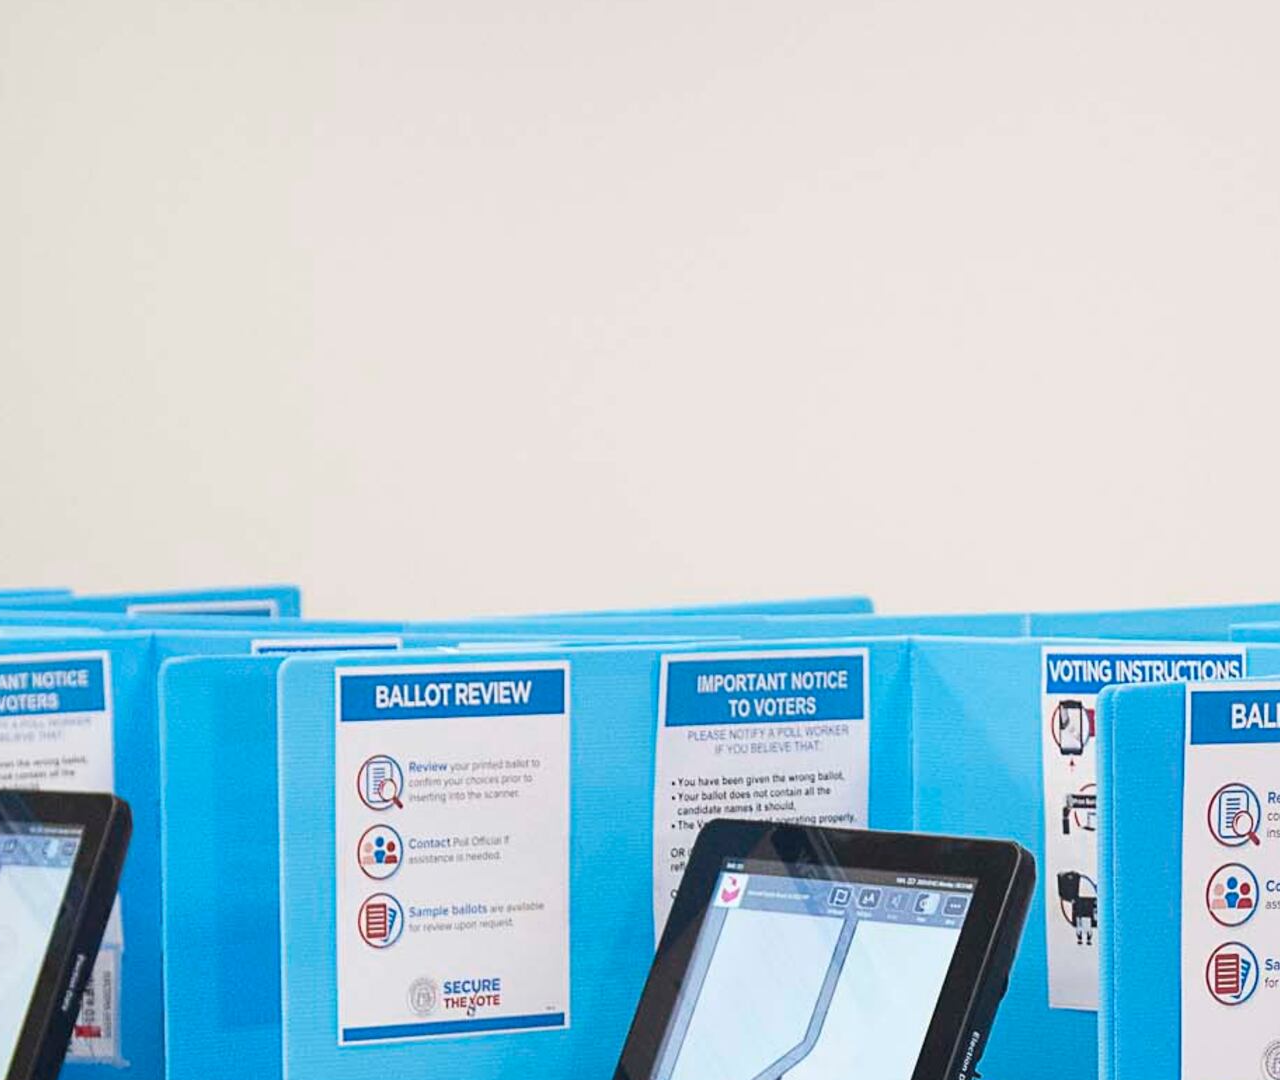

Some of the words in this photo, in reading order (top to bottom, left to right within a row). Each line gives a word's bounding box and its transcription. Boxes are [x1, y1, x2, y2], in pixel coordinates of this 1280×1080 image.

[32, 670, 89, 688] NOTICE
[1049, 660, 1111, 683] VOTING
[1117, 660, 1240, 681] INSTRUCTIONS
[697, 673, 787, 693] IMPORTANT
[791, 670, 848, 690] NOTICE
[376, 683, 451, 708] BALLOT
[455, 681, 532, 705] REVIEW
[728, 700, 750, 718] TO
[755, 697, 816, 716] VOTERS
[678, 777, 695, 786] You
[698, 777, 719, 786] have
[721, 776, 744, 785] been
[746, 776, 770, 786] given
[772, 774, 786, 782] the
[788, 773, 815, 783] wrong
[817, 772, 844, 780] ballot,
[409, 838, 451, 849] Contact
[409, 906, 449, 919] Sample
[452, 904, 487, 916] ballots
[444, 978, 501, 994] SECURE
[1264, 976, 1279, 988] for
[962, 1031, 980, 1072] Election
